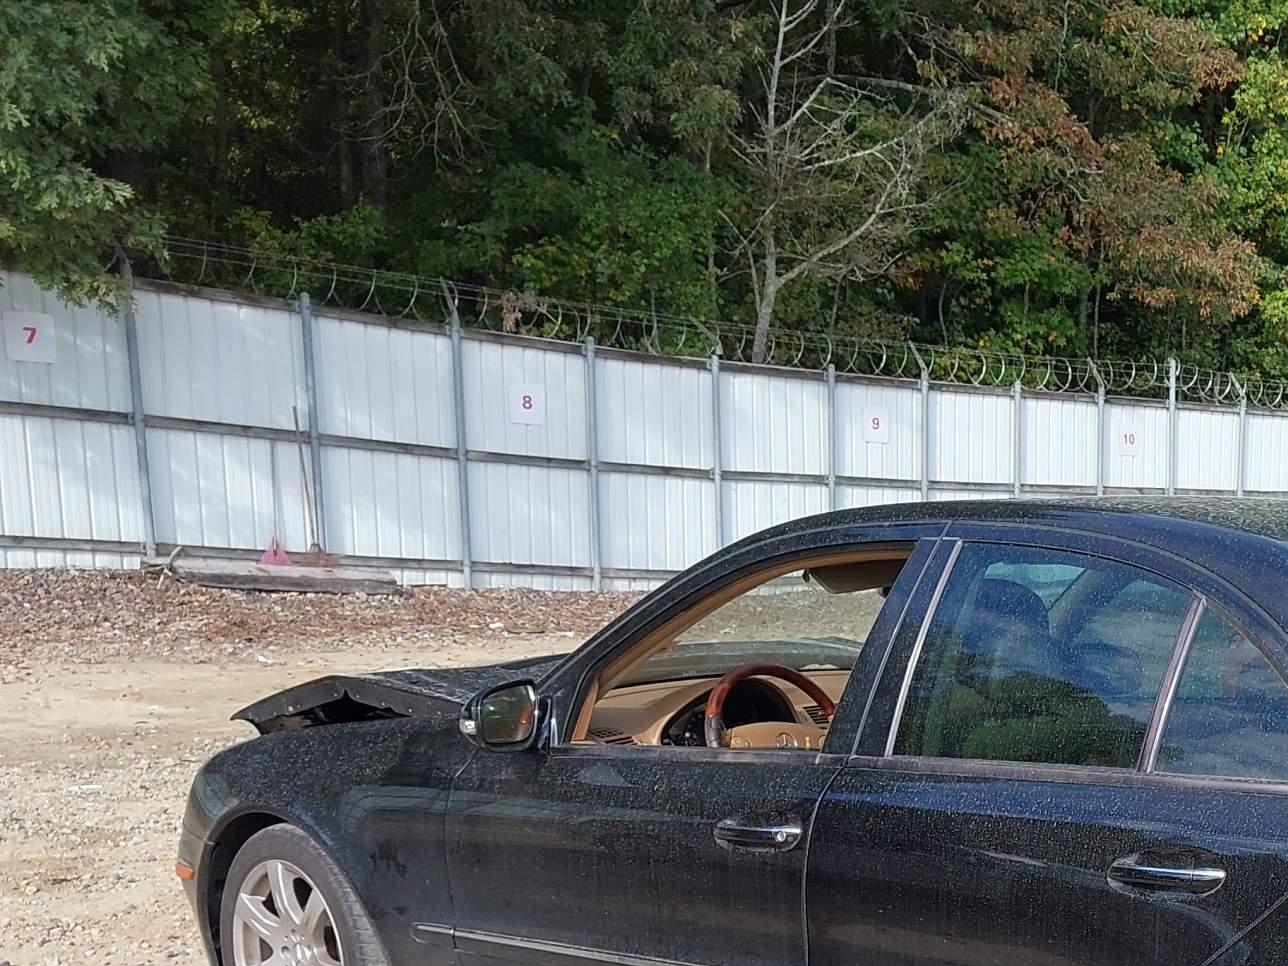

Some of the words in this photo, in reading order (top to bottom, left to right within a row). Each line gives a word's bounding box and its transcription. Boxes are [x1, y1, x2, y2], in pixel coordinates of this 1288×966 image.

[22, 326, 38, 344] 7
[521, 394, 534, 410] 8
[871, 416, 881, 430] 9
[1122, 433, 1136, 446] 10
